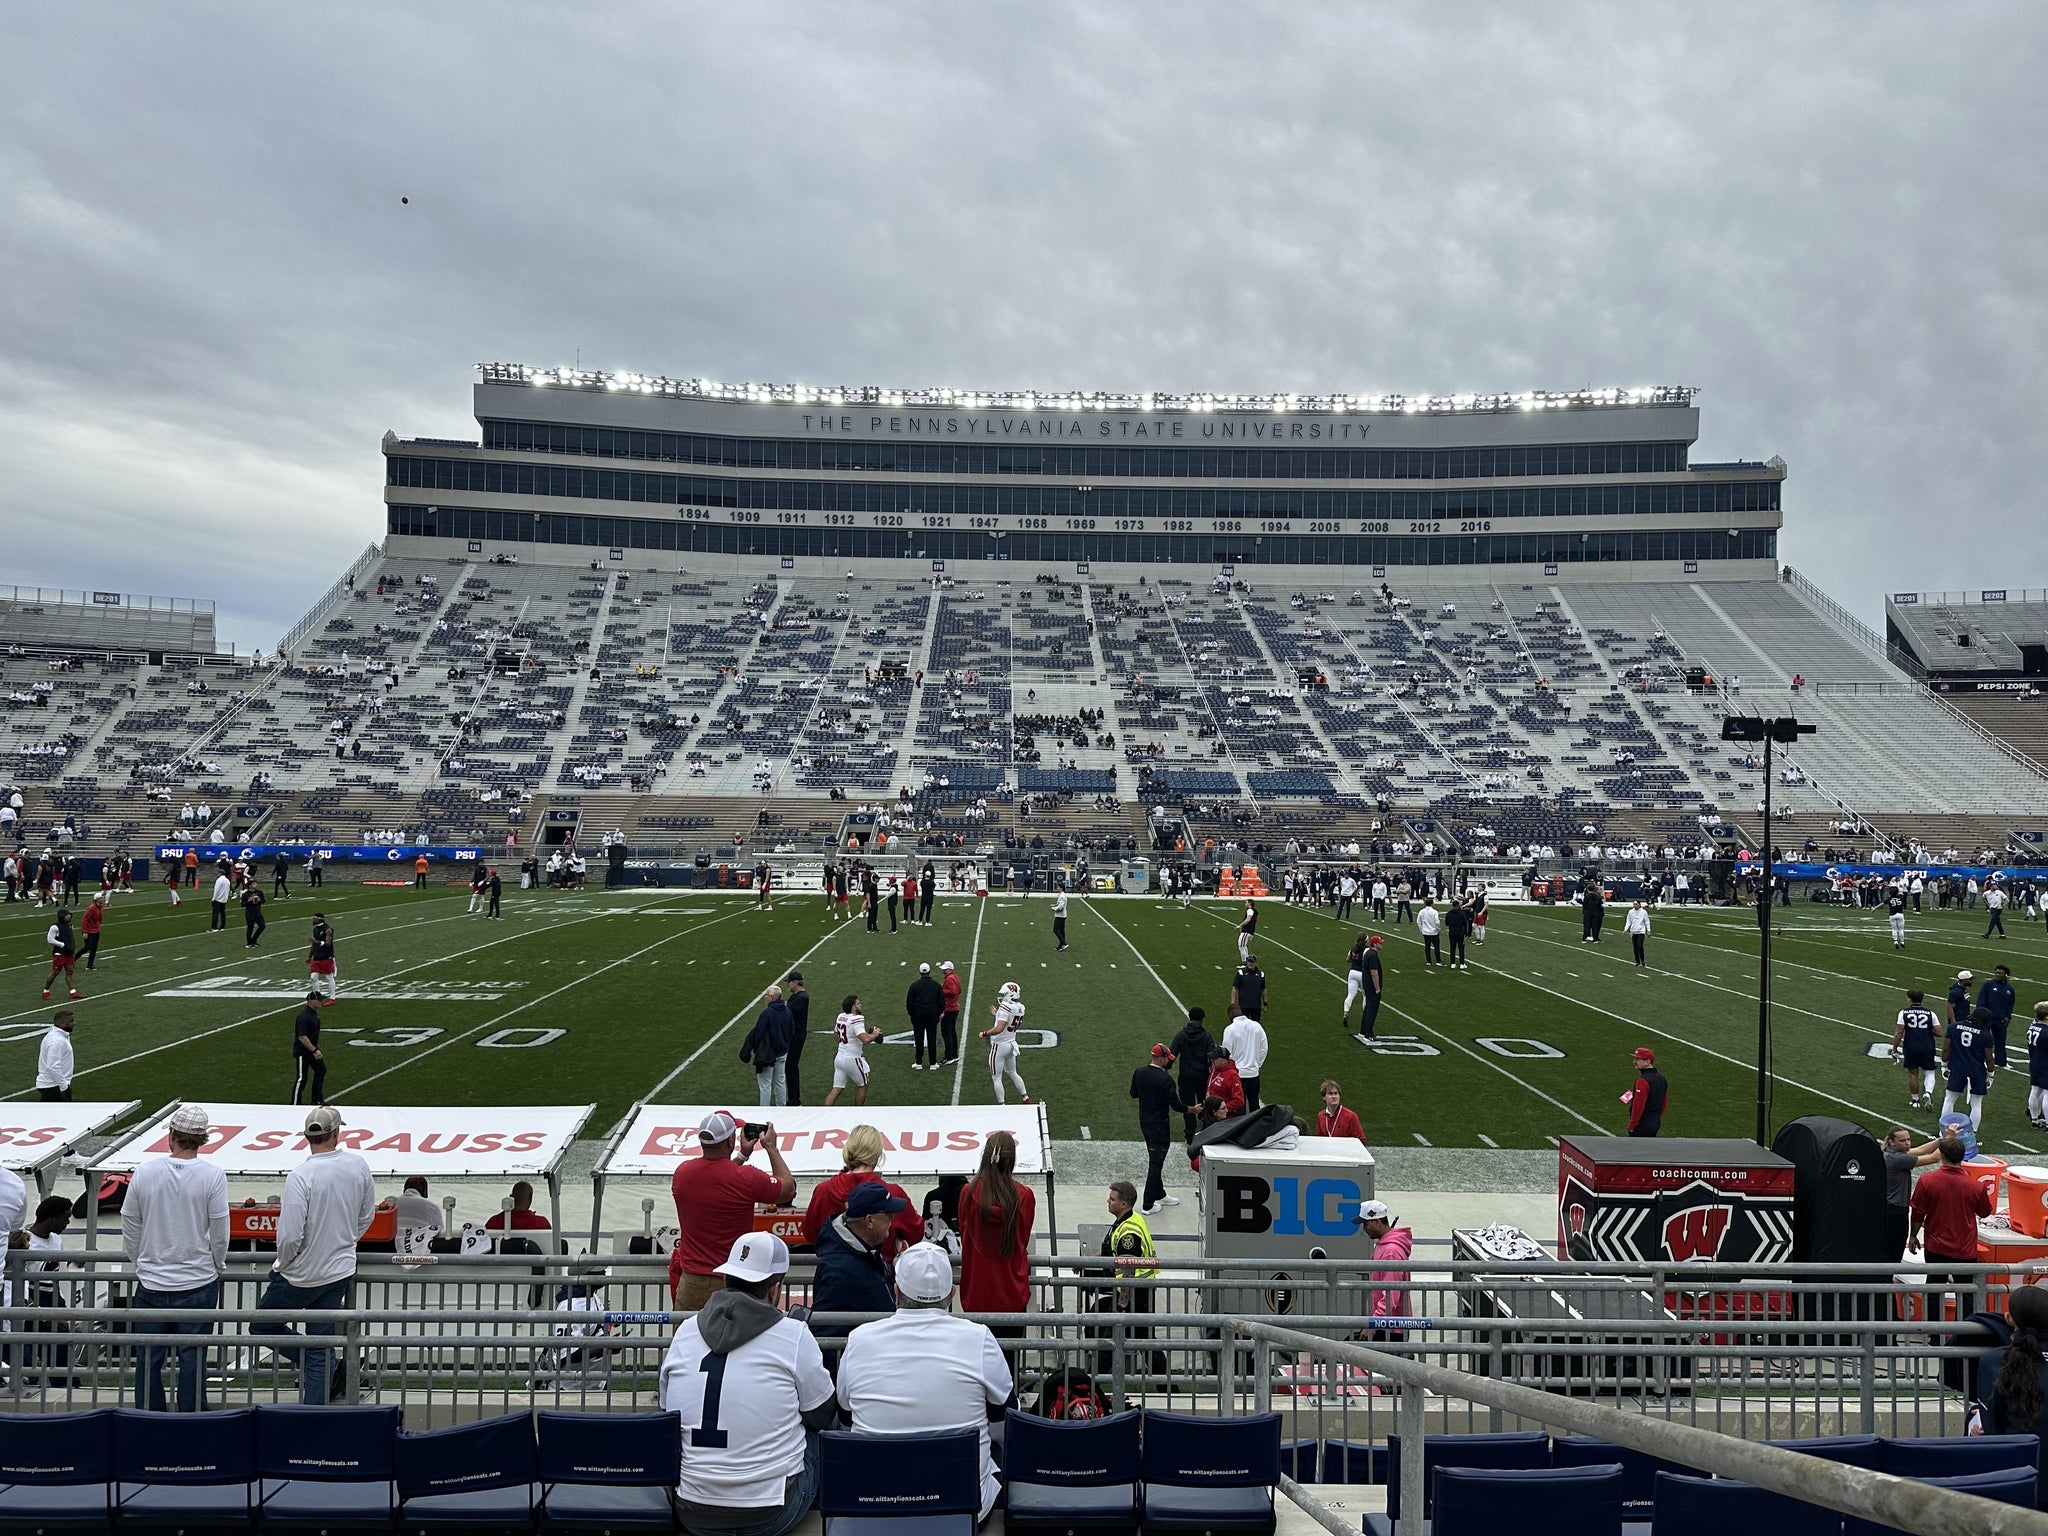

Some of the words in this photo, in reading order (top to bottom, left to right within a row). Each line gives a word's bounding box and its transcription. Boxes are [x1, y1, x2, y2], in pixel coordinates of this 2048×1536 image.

[802, 415, 852, 432] THE
[870, 416, 1083, 435] PENNSYLVANIA
[1100, 420, 1182, 437] STATE
[1202, 421, 1371, 439] UNIVERSITY
[678, 508, 710, 520] 1894
[730, 511, 760, 522] 1909
[777, 513, 806, 524] 1911
[824, 514, 855, 525] 1912
[873, 516, 903, 526] 1920
[922, 516, 951, 527] 1921
[969, 518, 999, 528] 1947
[1018, 518, 1048, 529] 1968
[1066, 519, 1096, 529] 1969
[1114, 520, 1144, 530] 1973
[1162, 520, 1192, 530] 1982
[1211, 520, 1241, 531] 1986
[1260, 521, 1290, 532] 1994
[1310, 522, 1340, 532] 2005
[1360, 522, 1389, 533] 2008
[1410, 522, 1440, 532] 2012
[1460, 521, 1490, 532] 2016
[2006, 682, 2031, 690] ZONE
[162, 849, 183, 858] PSU
[455, 851, 476, 859] PSU
[1890, 898, 1902, 907] 95
[1906, 1014, 1928, 1028] 32
[1961, 1031, 1973, 1047] 8
[2026, 1030, 2040, 1046] 37
[1652, 1169, 1747, 1180] coachcomm.com
[1661, 1204, 1733, 1262] W
[611, 1314, 622, 1322] NO
[625, 1314, 662, 1322] CLIMBING
[1389, 1320, 1426, 1328] CLIMBING
[691, 1351, 730, 1448] 1
[289, 1458, 359, 1466] www.nittanylionseats.com
[145, 1465, 216, 1473] www.nittanylionseats.com
[574, 1466, 644, 1474] www.nittanylionseats.com
[1037, 1468, 1106, 1476] www.nittanylionseats.com
[430, 1471, 501, 1485] www.nittanylionseats.com
[859, 1494, 939, 1503] www.nittanylionseats.com
